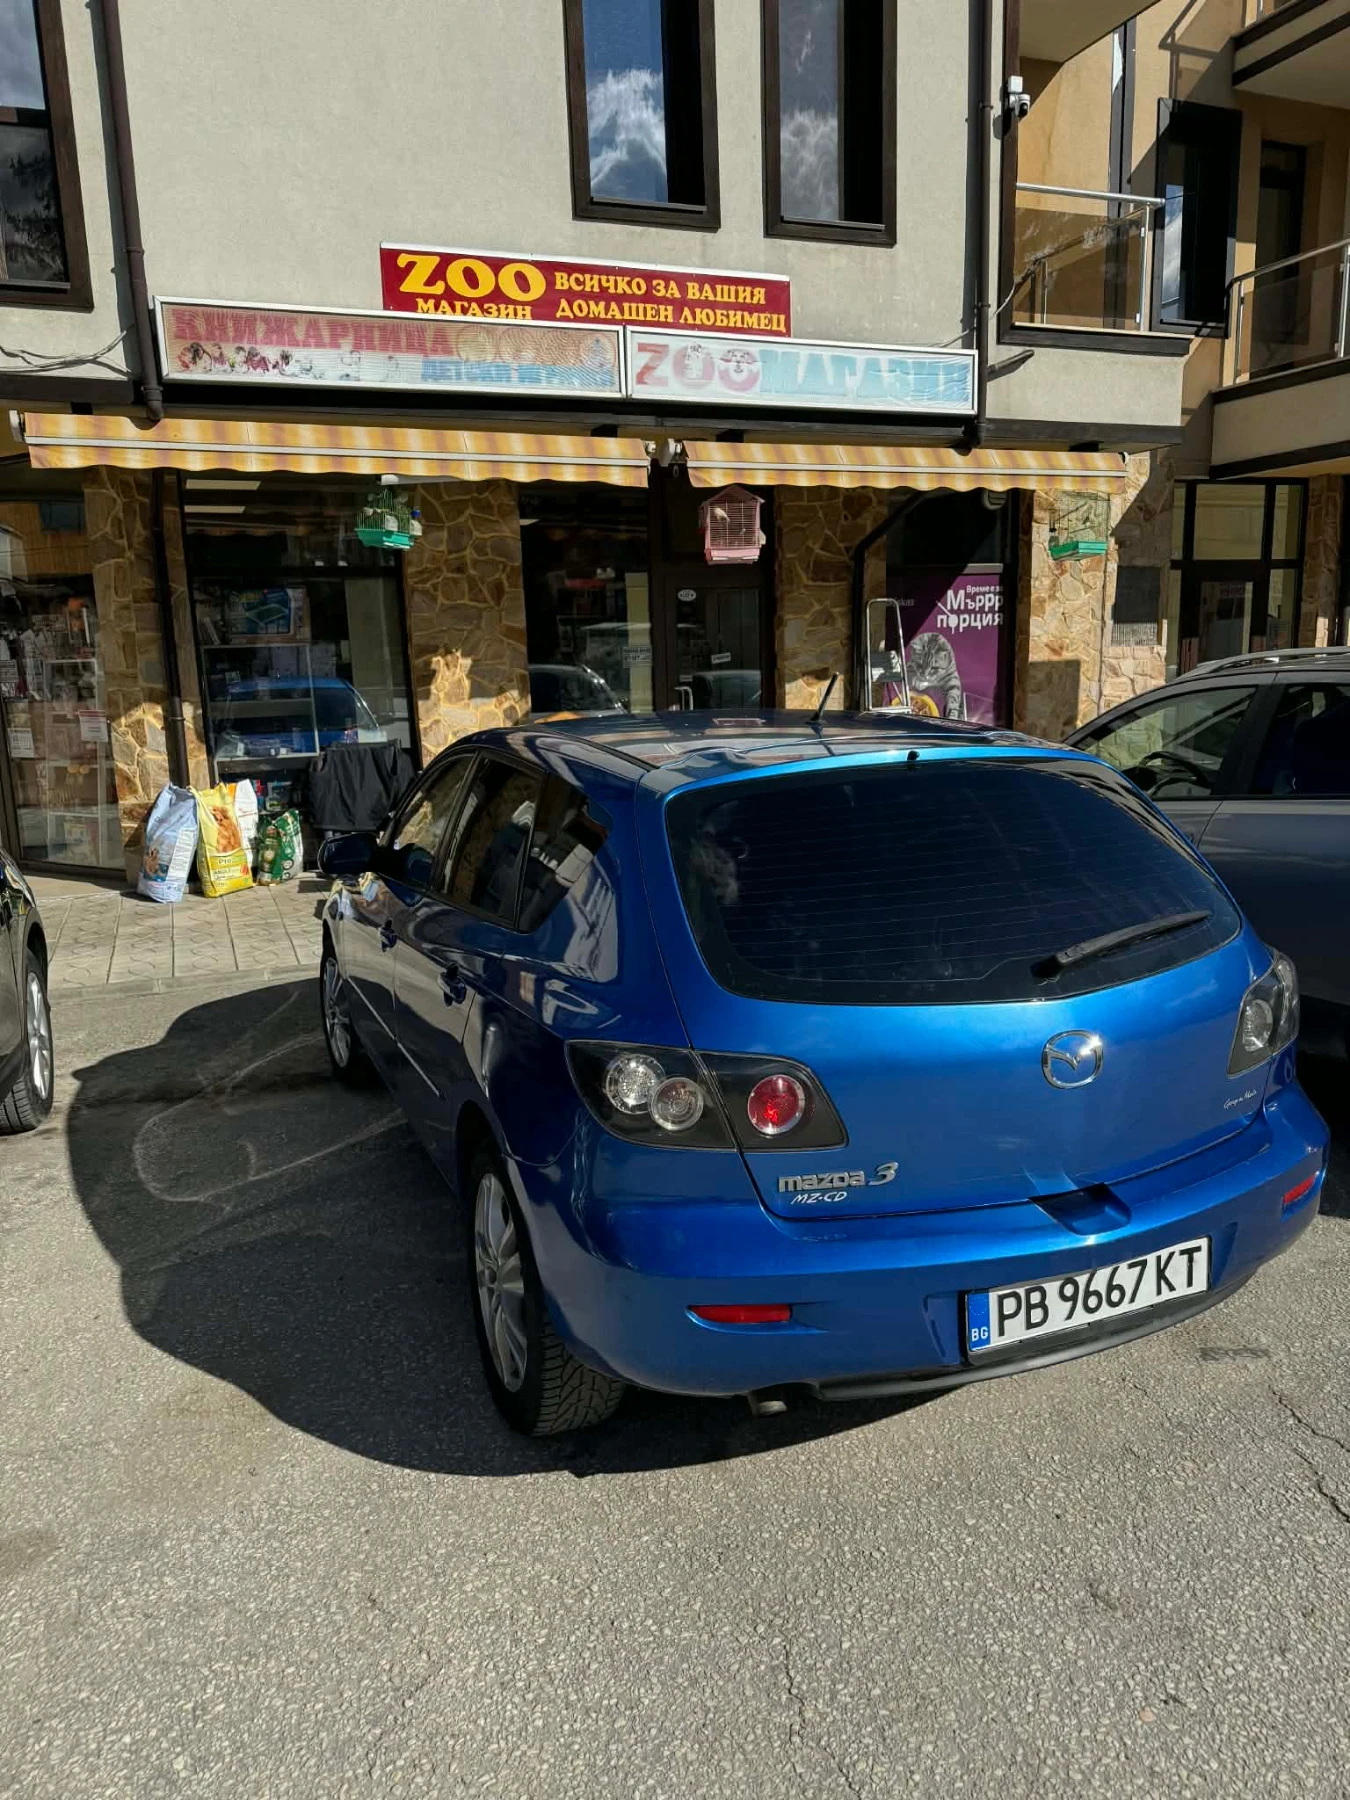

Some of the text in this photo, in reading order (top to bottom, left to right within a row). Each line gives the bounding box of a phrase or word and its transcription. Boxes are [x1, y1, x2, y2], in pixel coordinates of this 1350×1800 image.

[397, 253, 547, 302] ZOO
[555, 271, 766, 305] ВСИЧКО ЗА ВАШИЯ
[415, 298, 532, 320] МАГАЗИН
[555, 299, 787, 334] ДОМАШЕН ЛЮБИМЕЦ
[173, 308, 453, 357] КНИЖАРНИЦА
[937, 613, 1004, 633] порция
[779, 1161, 899, 1193] mazda 3
[790, 1191, 848, 1205] MZ-CD
[997, 1244, 1203, 1338] PB 9667 KT
[971, 1328, 989, 1342] BG
